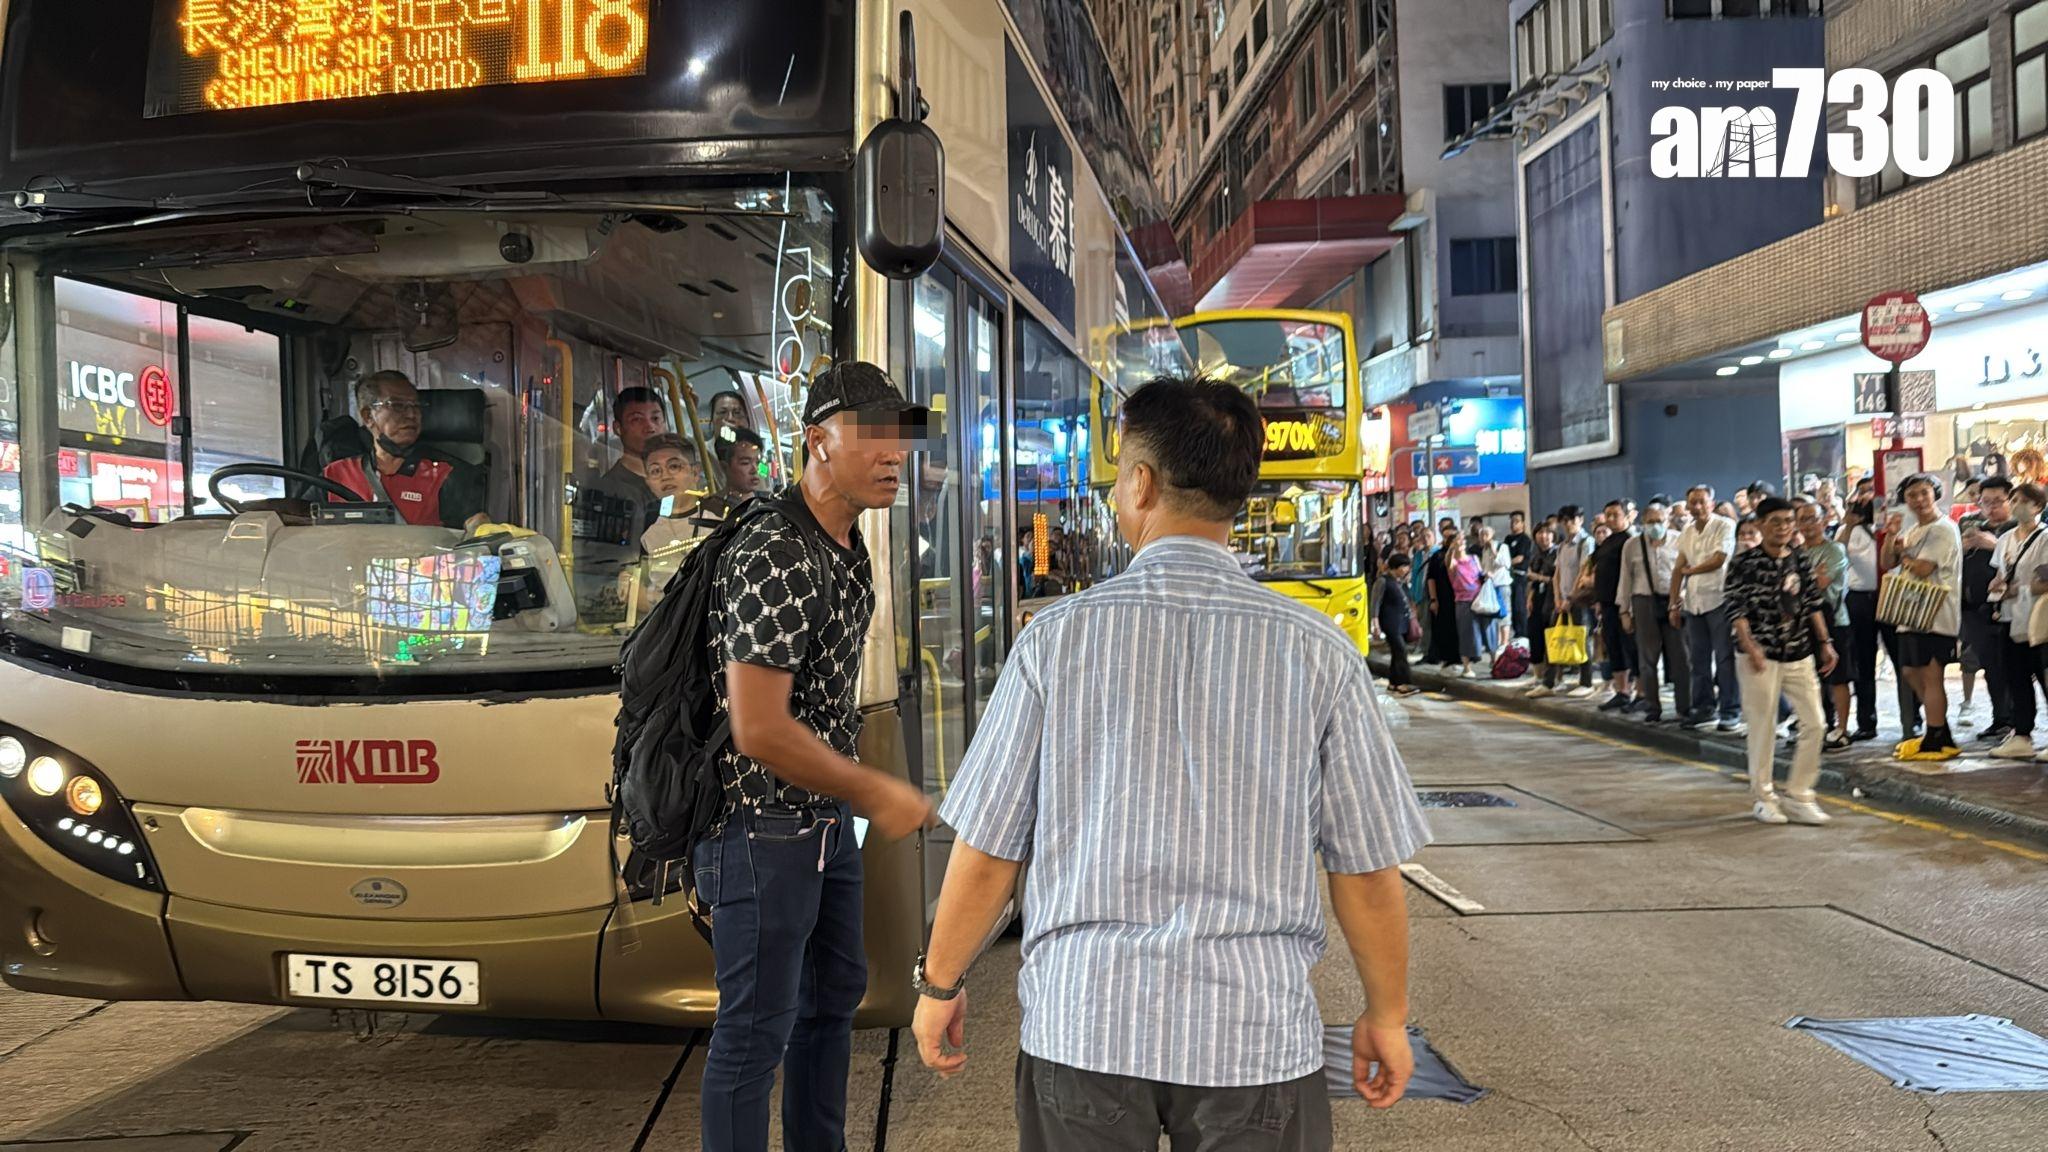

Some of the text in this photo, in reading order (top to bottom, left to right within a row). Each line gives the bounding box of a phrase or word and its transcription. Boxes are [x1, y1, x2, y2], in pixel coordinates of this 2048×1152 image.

[220, 27, 463, 79] CHEUNG SHA WAN
[516, 0, 645, 79] 118
[305, 66, 382, 102] MONG
[71, 360, 136, 408] ICBC
[1856, 374, 1885, 392] YT
[1856, 392, 1887, 412] 146
[1266, 421, 1316, 451] 970X
[334, 740, 440, 784] KMB
[306, 960, 462, 999] TS 8156
